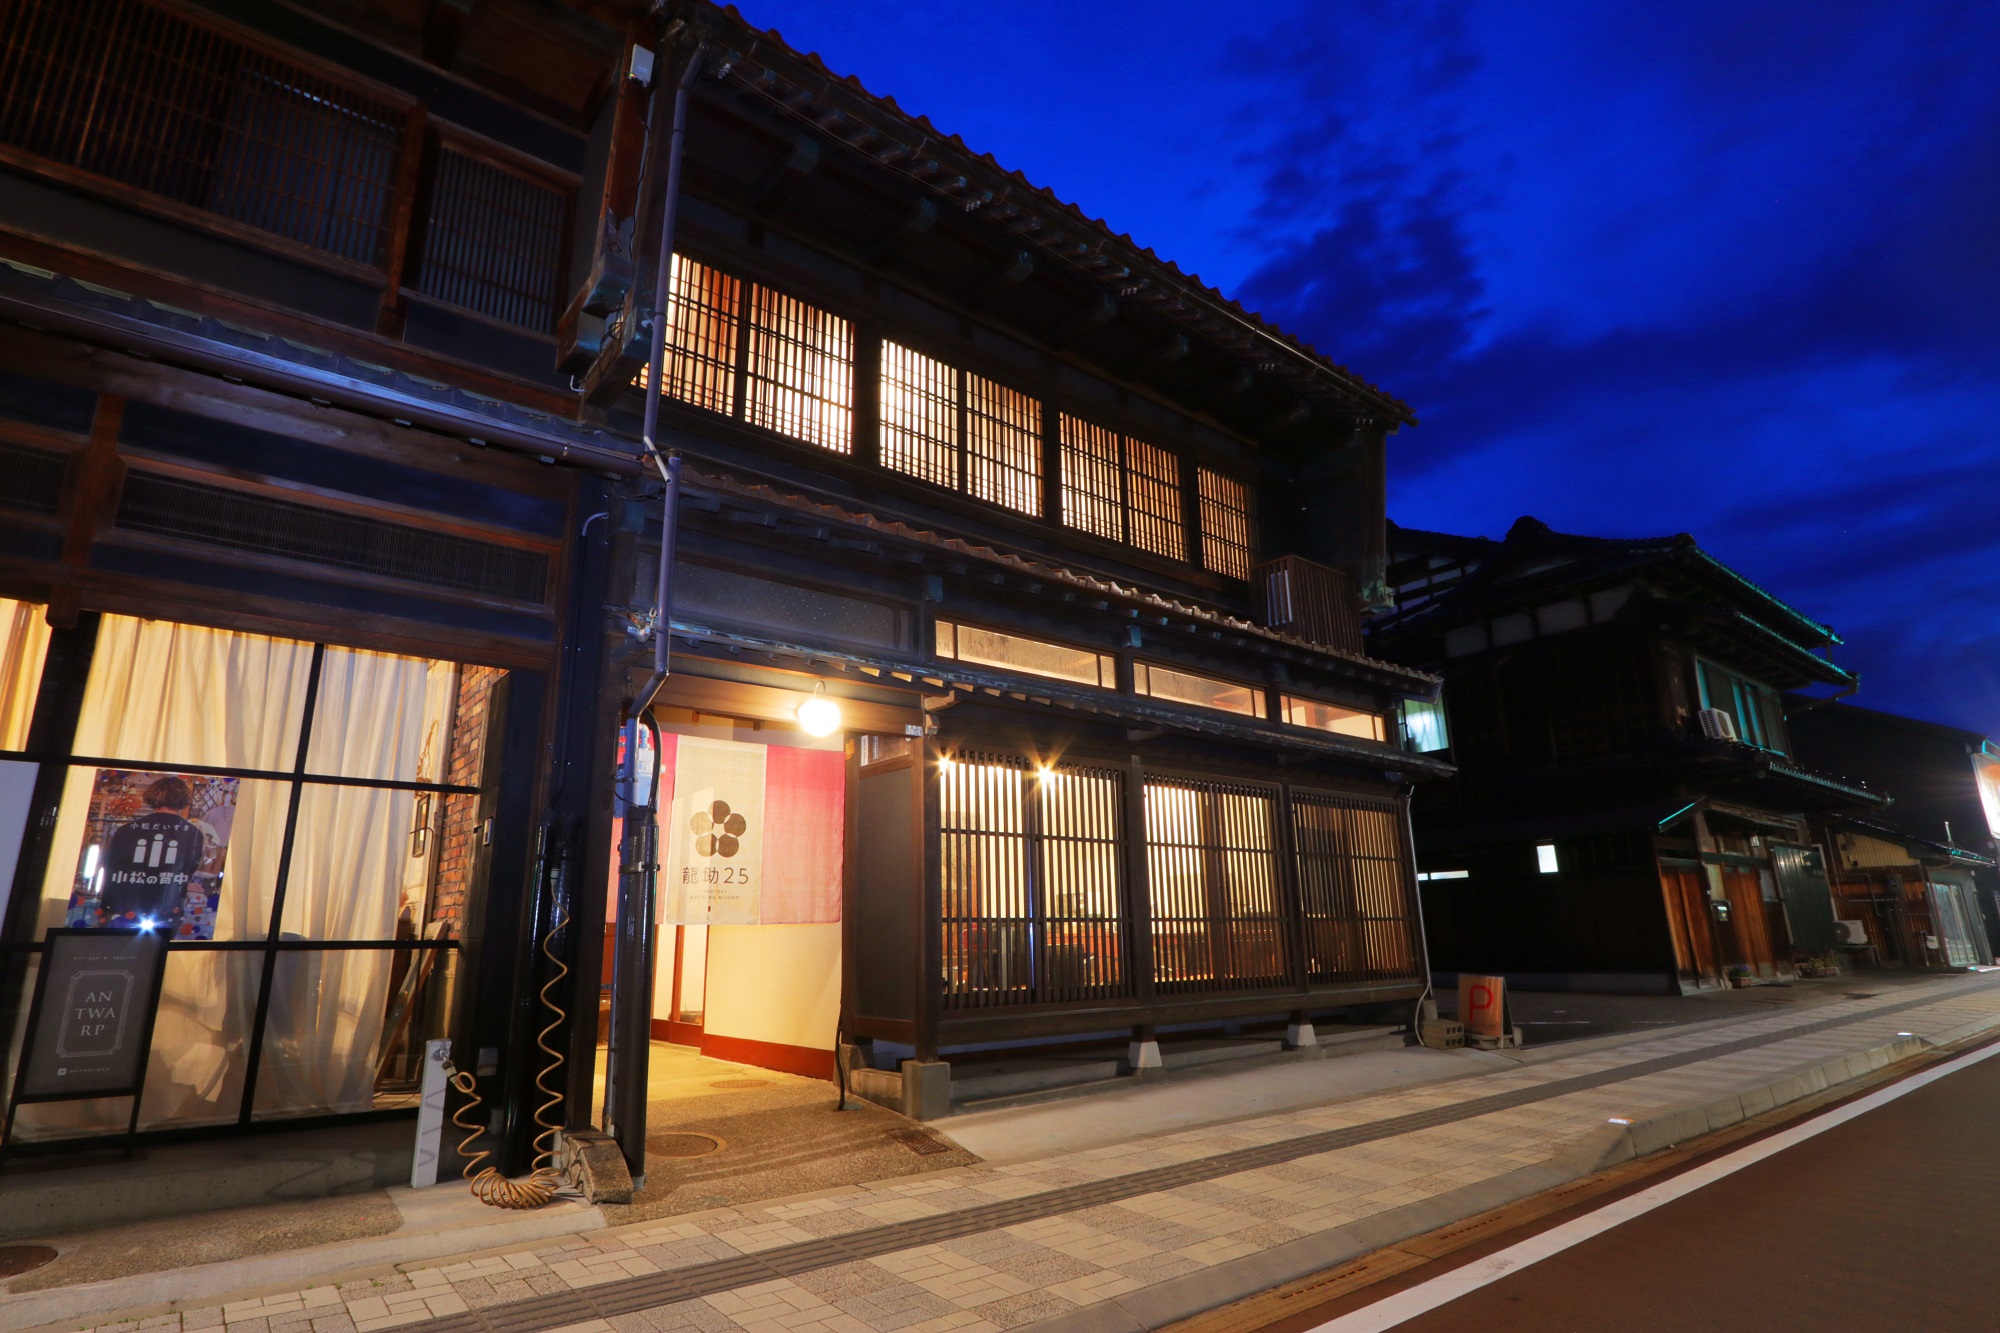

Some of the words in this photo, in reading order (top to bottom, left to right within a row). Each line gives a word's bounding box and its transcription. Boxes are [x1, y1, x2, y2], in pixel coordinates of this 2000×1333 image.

[130, 822, 190, 832] 小松だいすき
[111, 870, 189, 885] 小松の背中
[682, 867, 749, 884] 龍助25
[85, 991, 112, 1003] AN
[1469, 985, 1493, 1021] P
[75, 1008, 115, 1019] TWA
[80, 1025, 105, 1036] RP
